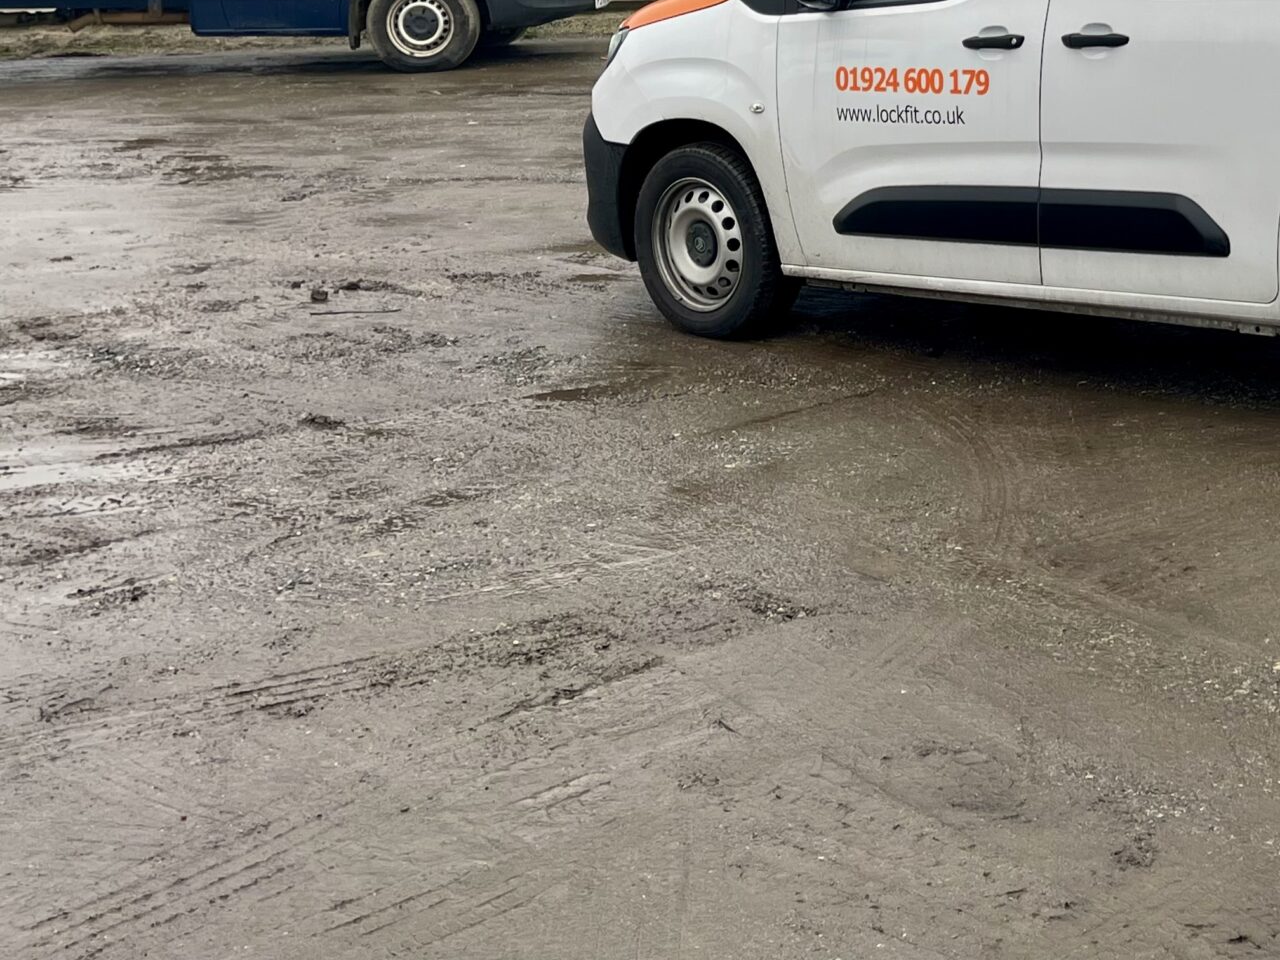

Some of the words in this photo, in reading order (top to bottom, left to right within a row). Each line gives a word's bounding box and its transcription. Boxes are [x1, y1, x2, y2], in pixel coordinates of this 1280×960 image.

[835, 66, 900, 93] 01924
[904, 68, 944, 94] 600
[949, 69, 990, 96] 179
[836, 104, 966, 125] www.lockfit.co.uk
